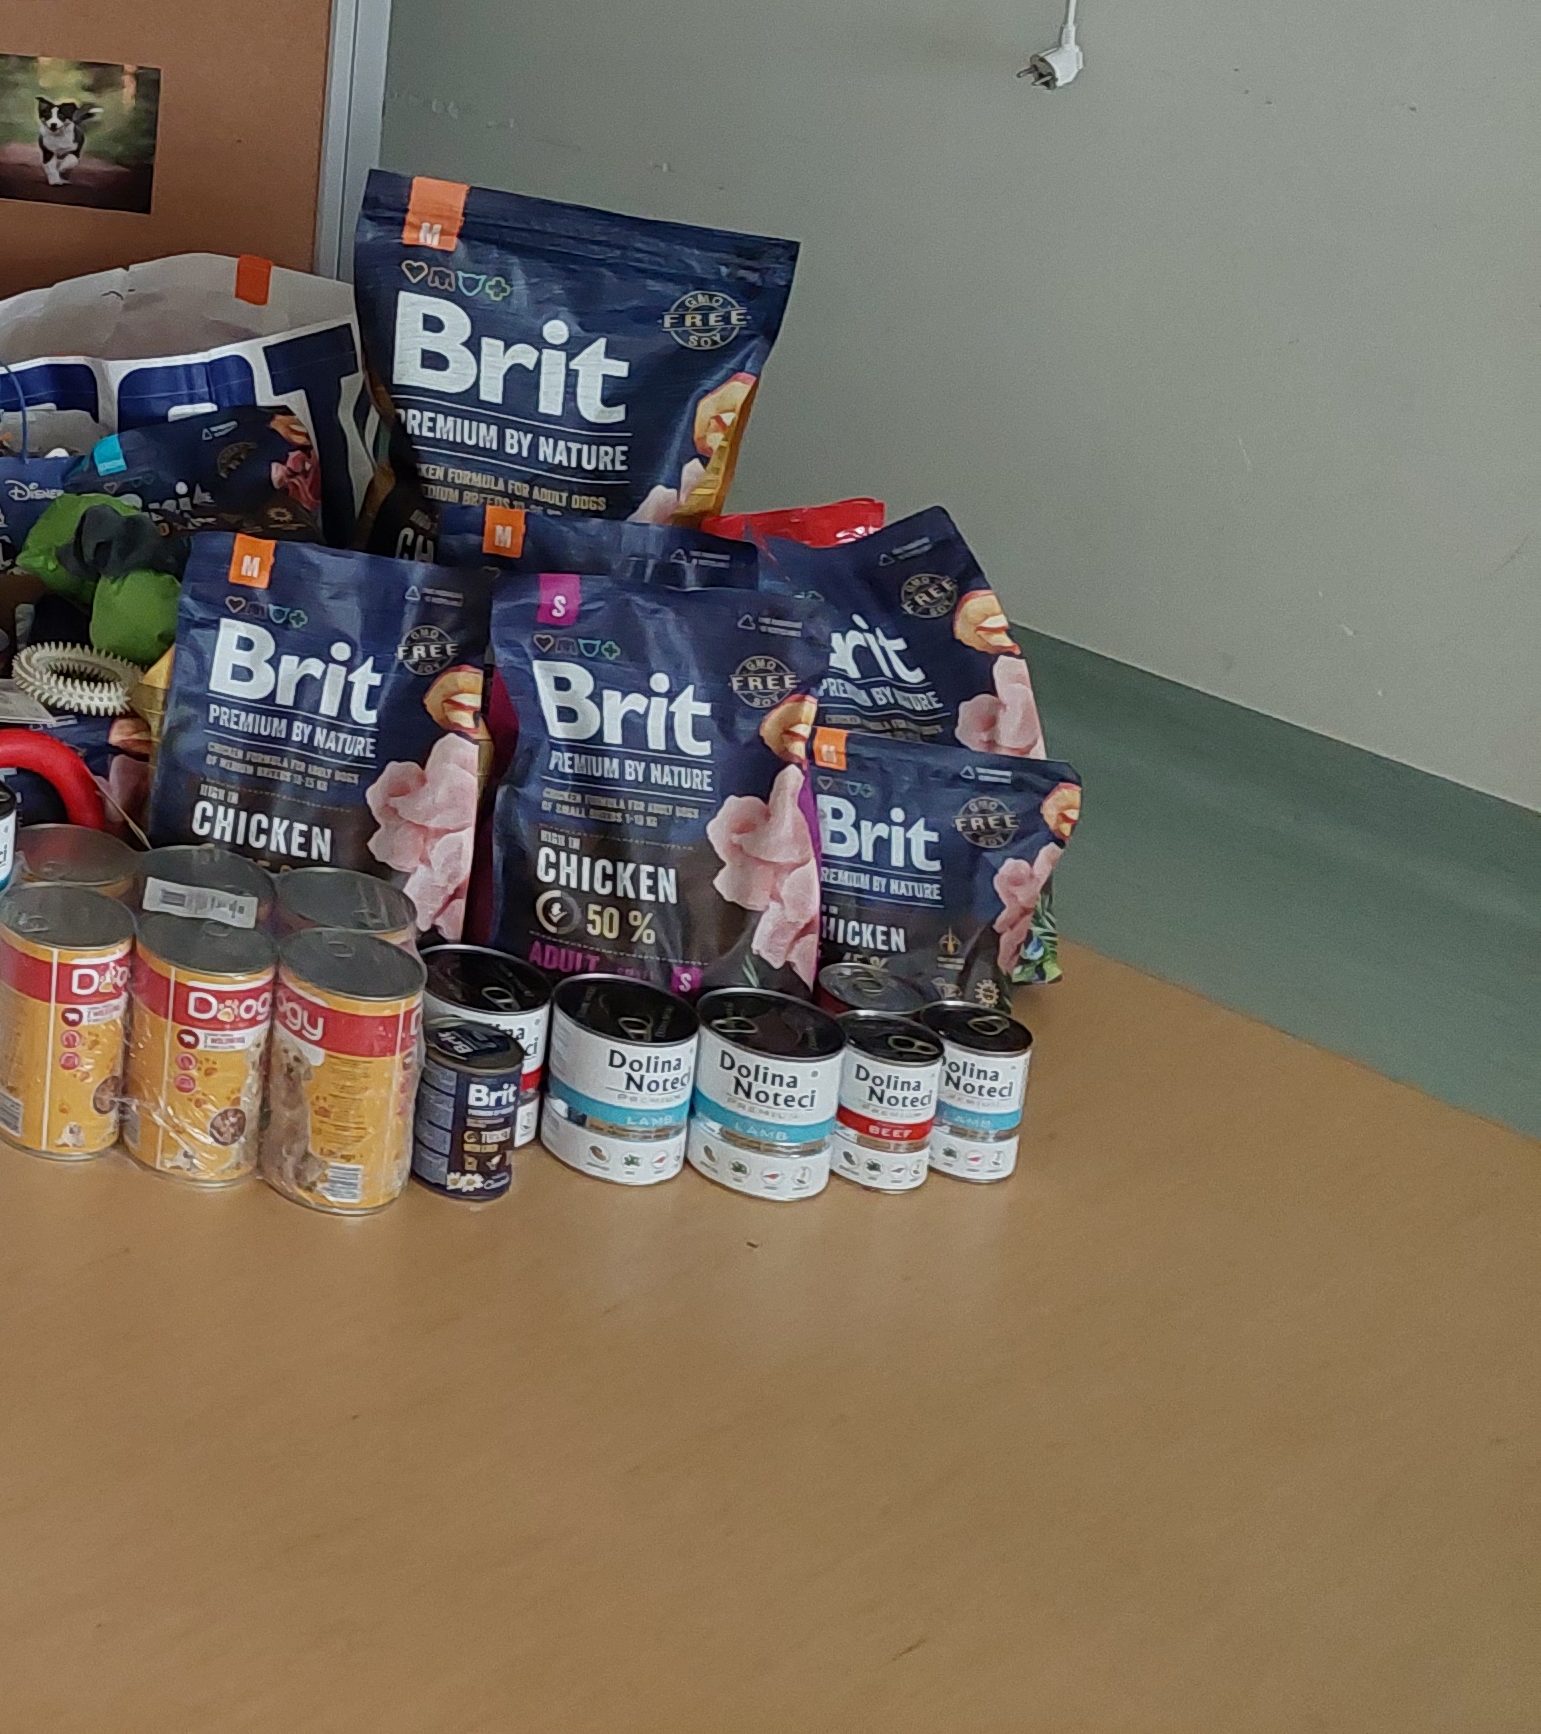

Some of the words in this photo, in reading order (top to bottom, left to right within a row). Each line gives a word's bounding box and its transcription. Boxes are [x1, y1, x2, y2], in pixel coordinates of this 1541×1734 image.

[419, 221, 443, 247] M
[685, 294, 723, 307] GMO
[663, 310, 749, 328] FREE
[688, 335, 724, 347] SOY
[392, 291, 630, 424] Brit
[397, 408, 499, 451] PREMIUM
[505, 427, 533, 459] BY
[538, 436, 629, 471] NATURE
[571, 491, 607, 512] DOGS
[495, 525, 512, 546] M
[241, 554, 260, 578] M
[551, 595, 567, 618] S
[902, 576, 957, 616] FREE
[397, 643, 459, 660] FREE
[208, 618, 383, 725] Brit
[731, 674, 798, 691] FREE
[533, 660, 713, 756] Brit
[208, 703, 287, 739] PREMIUM
[291, 722, 313, 744] BY
[315, 728, 377, 759] NATURE
[624, 760, 646, 782] BY
[650, 764, 714, 792] NATURE
[191, 800, 332, 863] CHICKEN
[818, 795, 942, 871] Brit
[954, 816, 1020, 832] FREE
[536, 846, 678, 904] CHICKEN
[873, 875, 888, 894] BY
[891, 879, 942, 901] NATURE
[586, 903, 620, 939] 50
[628, 911, 656, 945] %
[529, 940, 600, 973] ADULT
[679, 972, 693, 992] S
[608, 1049, 683, 1074] Dolina
[719, 1052, 799, 1089] Dolina
[854, 1063, 923, 1090] Dolina
[944, 1070, 1014, 1099] Noteci
[468, 1083, 517, 1107] Brit
[733, 1073, 817, 1109] Noteci
[868, 1080, 934, 1108] Noteci
[734, 1121, 789, 1142] LAMB
[868, 1125, 913, 1138] BEEF
